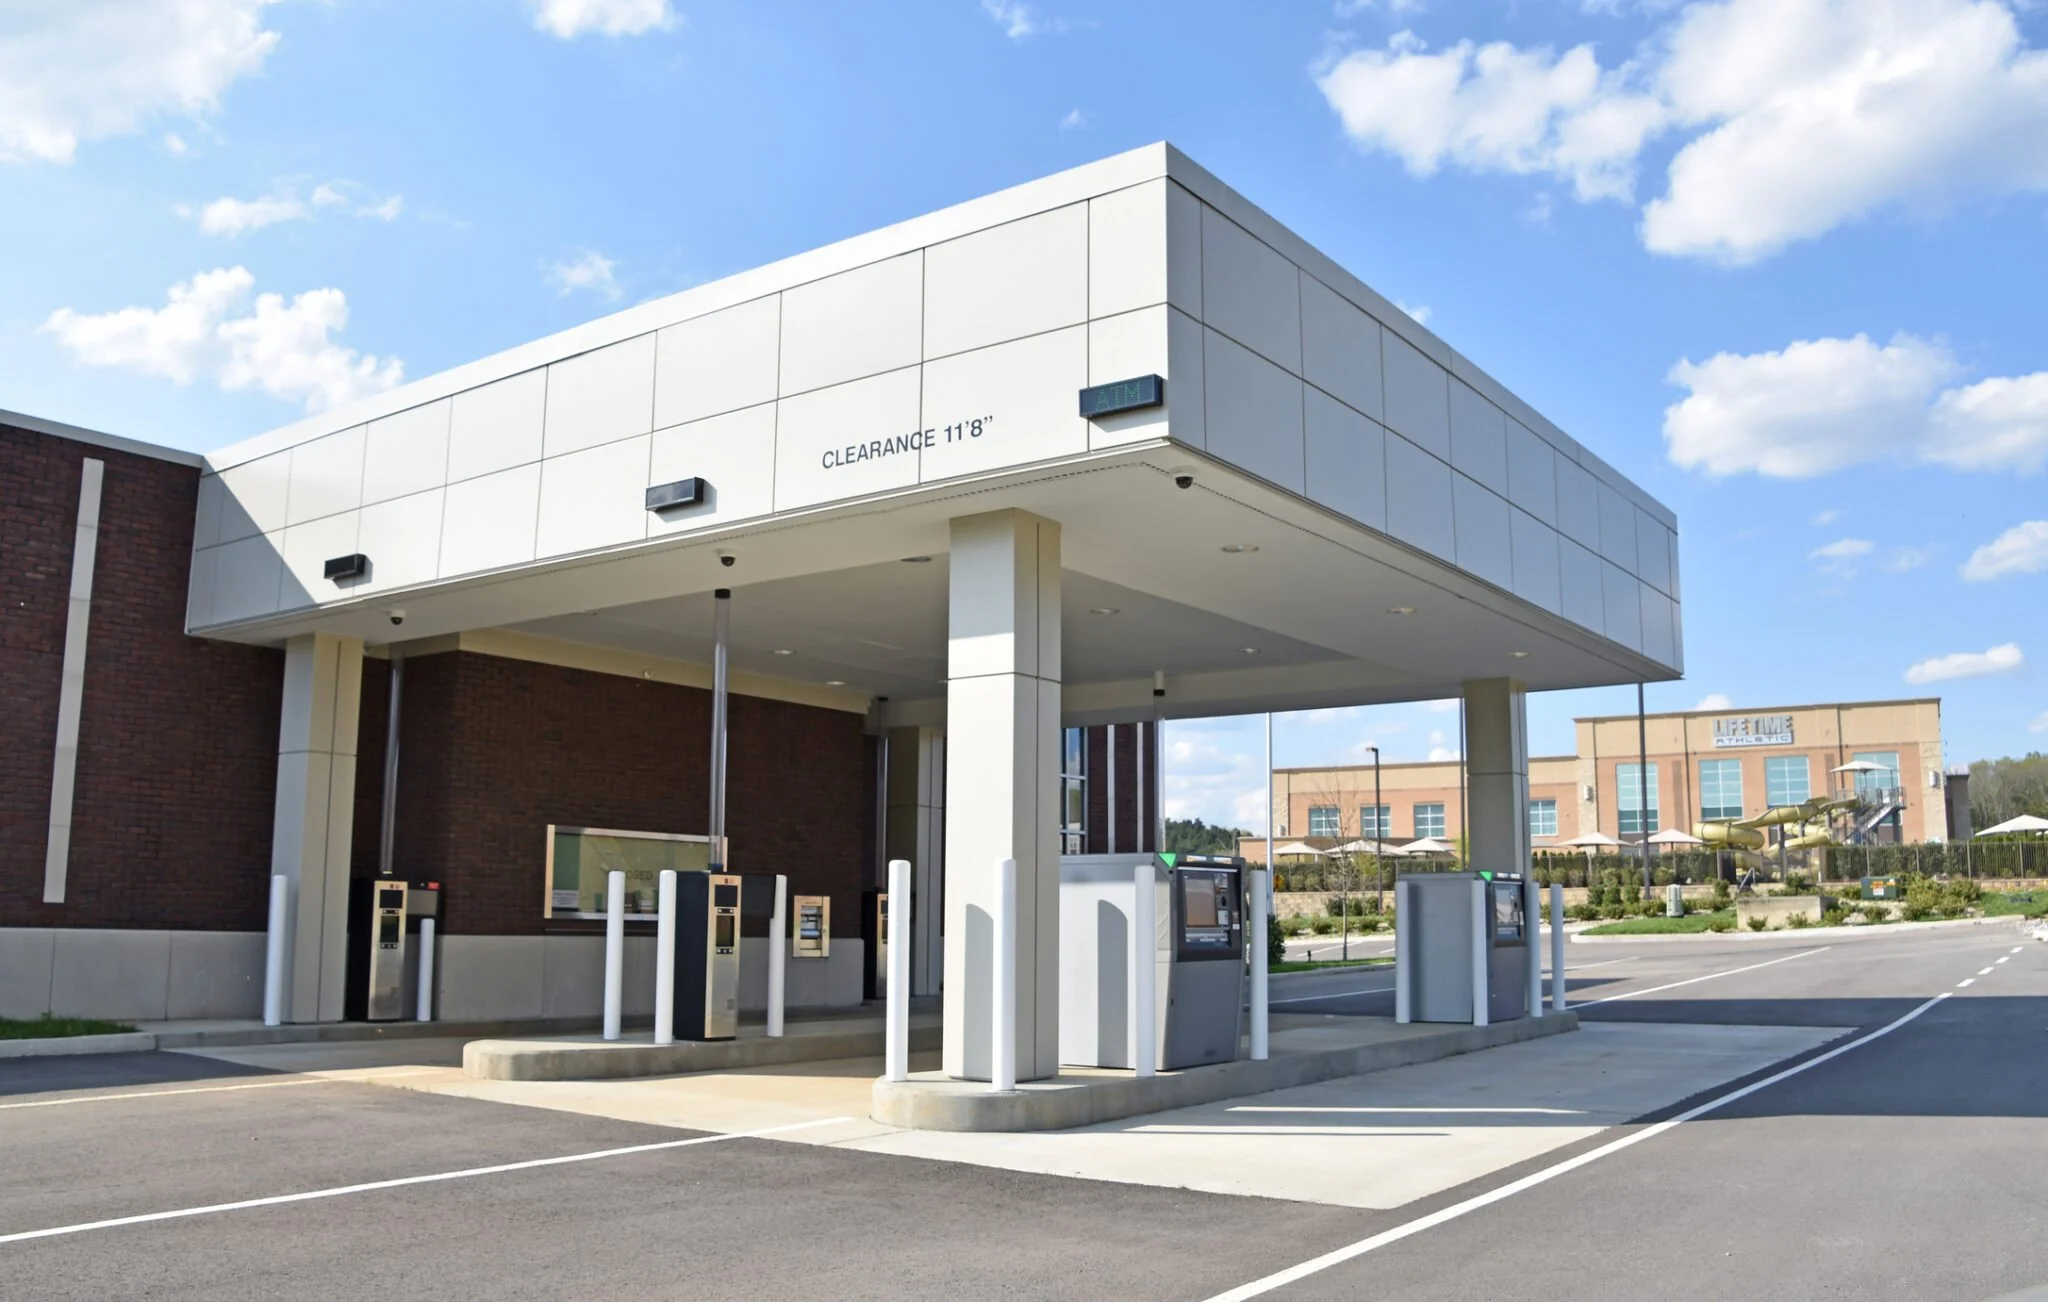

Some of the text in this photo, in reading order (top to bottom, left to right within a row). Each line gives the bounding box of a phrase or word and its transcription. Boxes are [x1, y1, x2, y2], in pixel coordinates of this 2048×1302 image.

[1096, 381, 1140, 412] ATM
[822, 429, 936, 469] CLEARANCE
[1716, 734, 1789, 745] ATHLETIC
[626, 870, 654, 881] OSED
